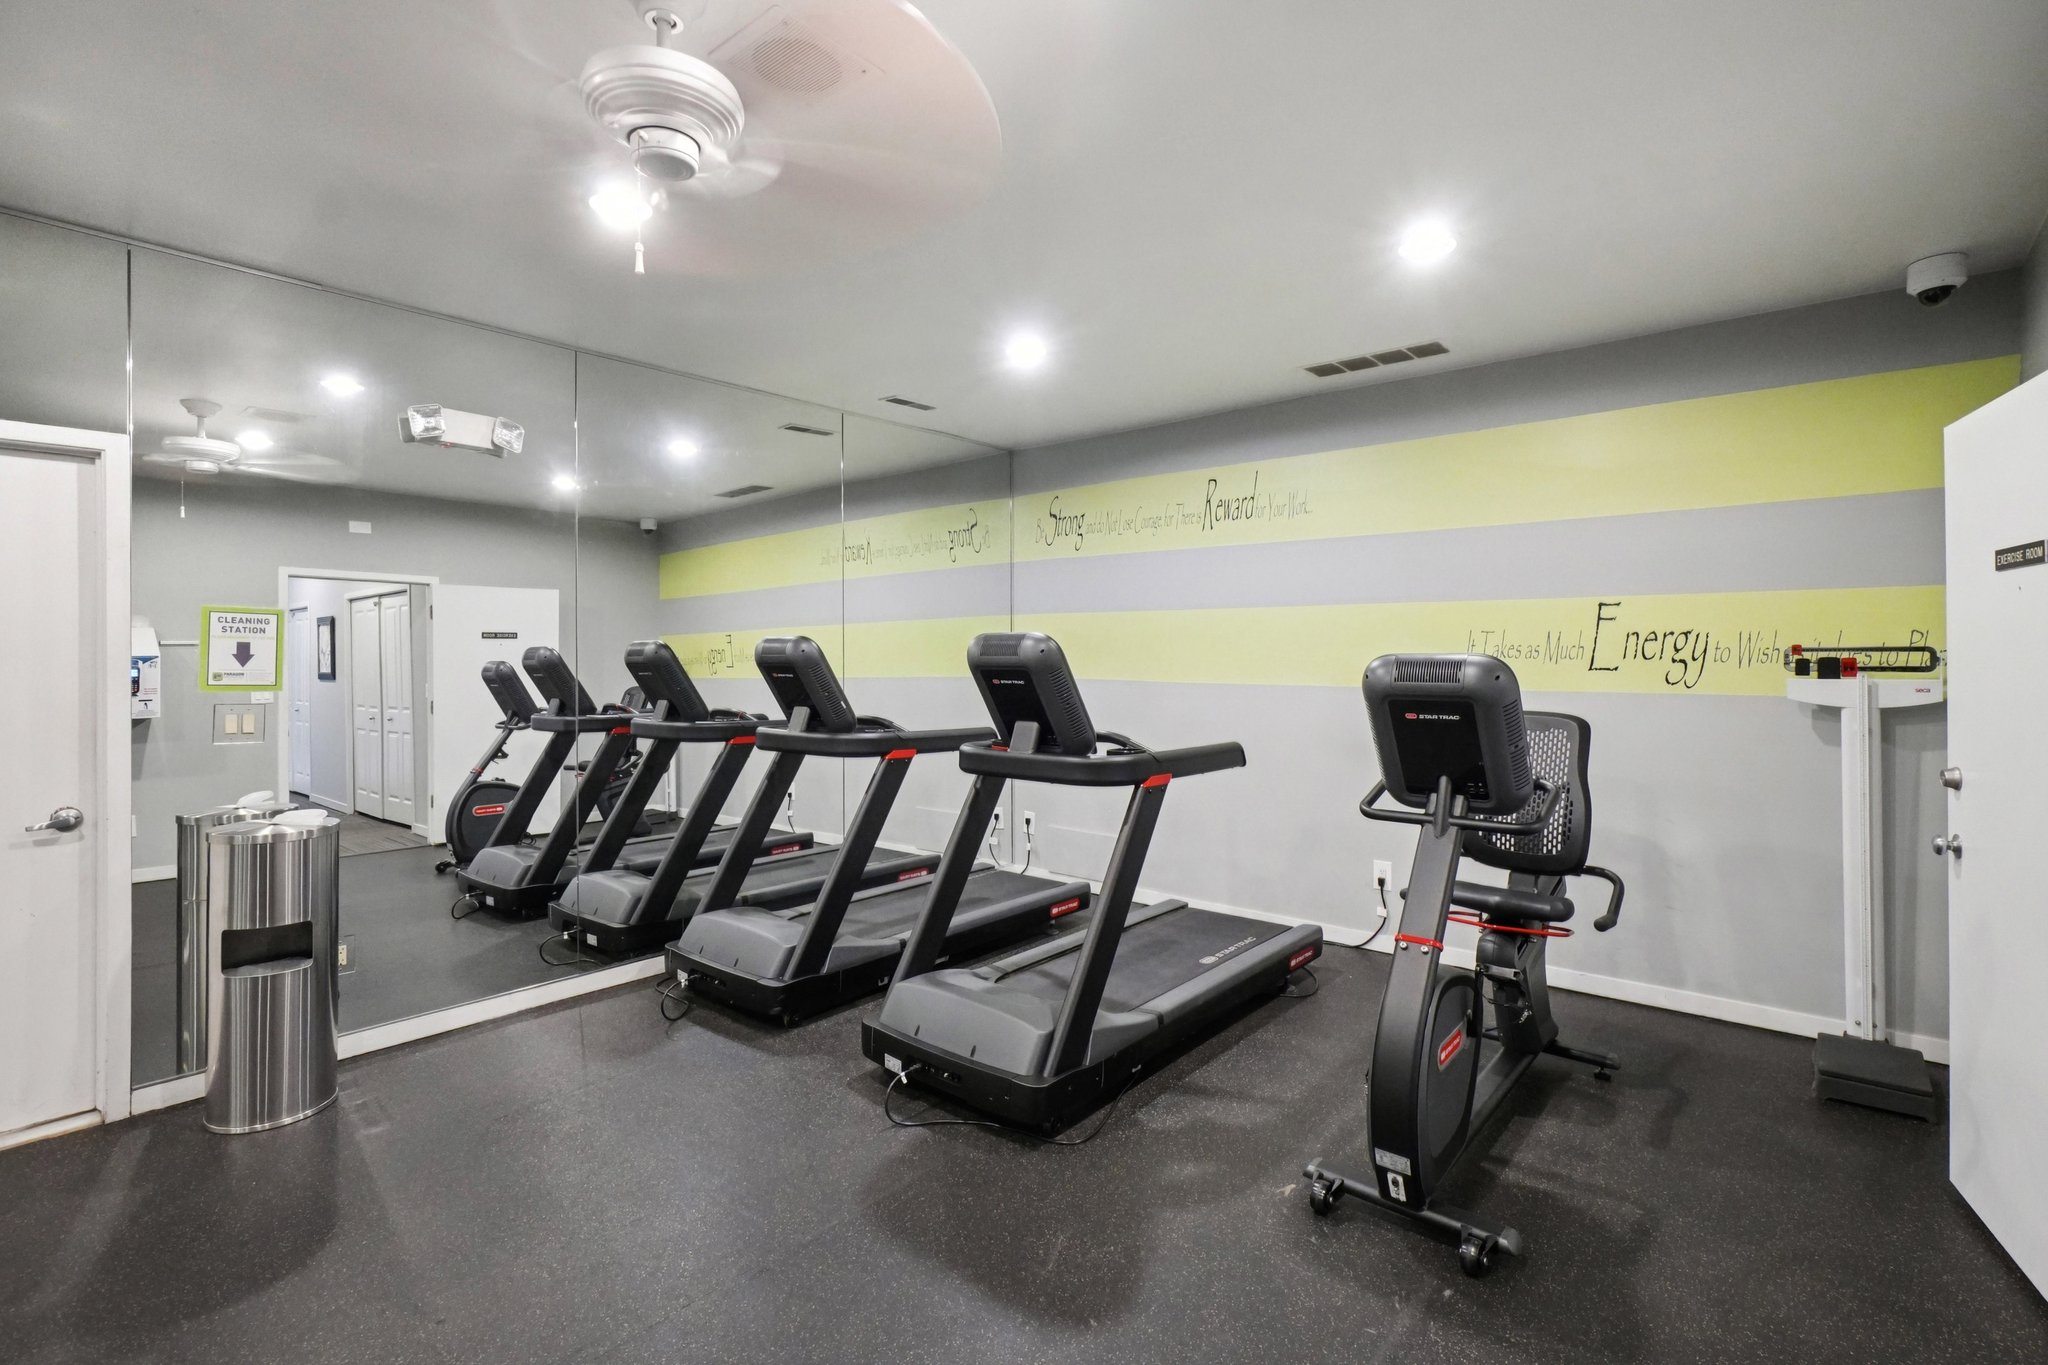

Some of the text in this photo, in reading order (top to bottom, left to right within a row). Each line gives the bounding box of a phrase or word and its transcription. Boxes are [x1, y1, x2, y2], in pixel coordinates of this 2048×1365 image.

[1044, 495, 1086, 552] Strong
[1104, 510, 1119, 536] Not
[1117, 509, 1134, 536] Lose
[1175, 503, 1196, 530] There
[1202, 470, 1259, 532] Reward
[1267, 492, 1286, 521] Your
[1996, 545, 2044, 566] EXERCISE ROOM
[217, 616, 270, 625] CLEANING
[221, 626, 266, 634] STATION
[1480, 629, 1522, 660] Takes
[1525, 643, 1541, 660] as
[1543, 629, 1586, 665] Much
[1588, 601, 1710, 689] Energy
[1713, 639, 1731, 664] to
[1738, 629, 1781, 669] Wish
[1878, 642, 1899, 666] to
[1215, 936, 1257, 958] STAR TRAC
